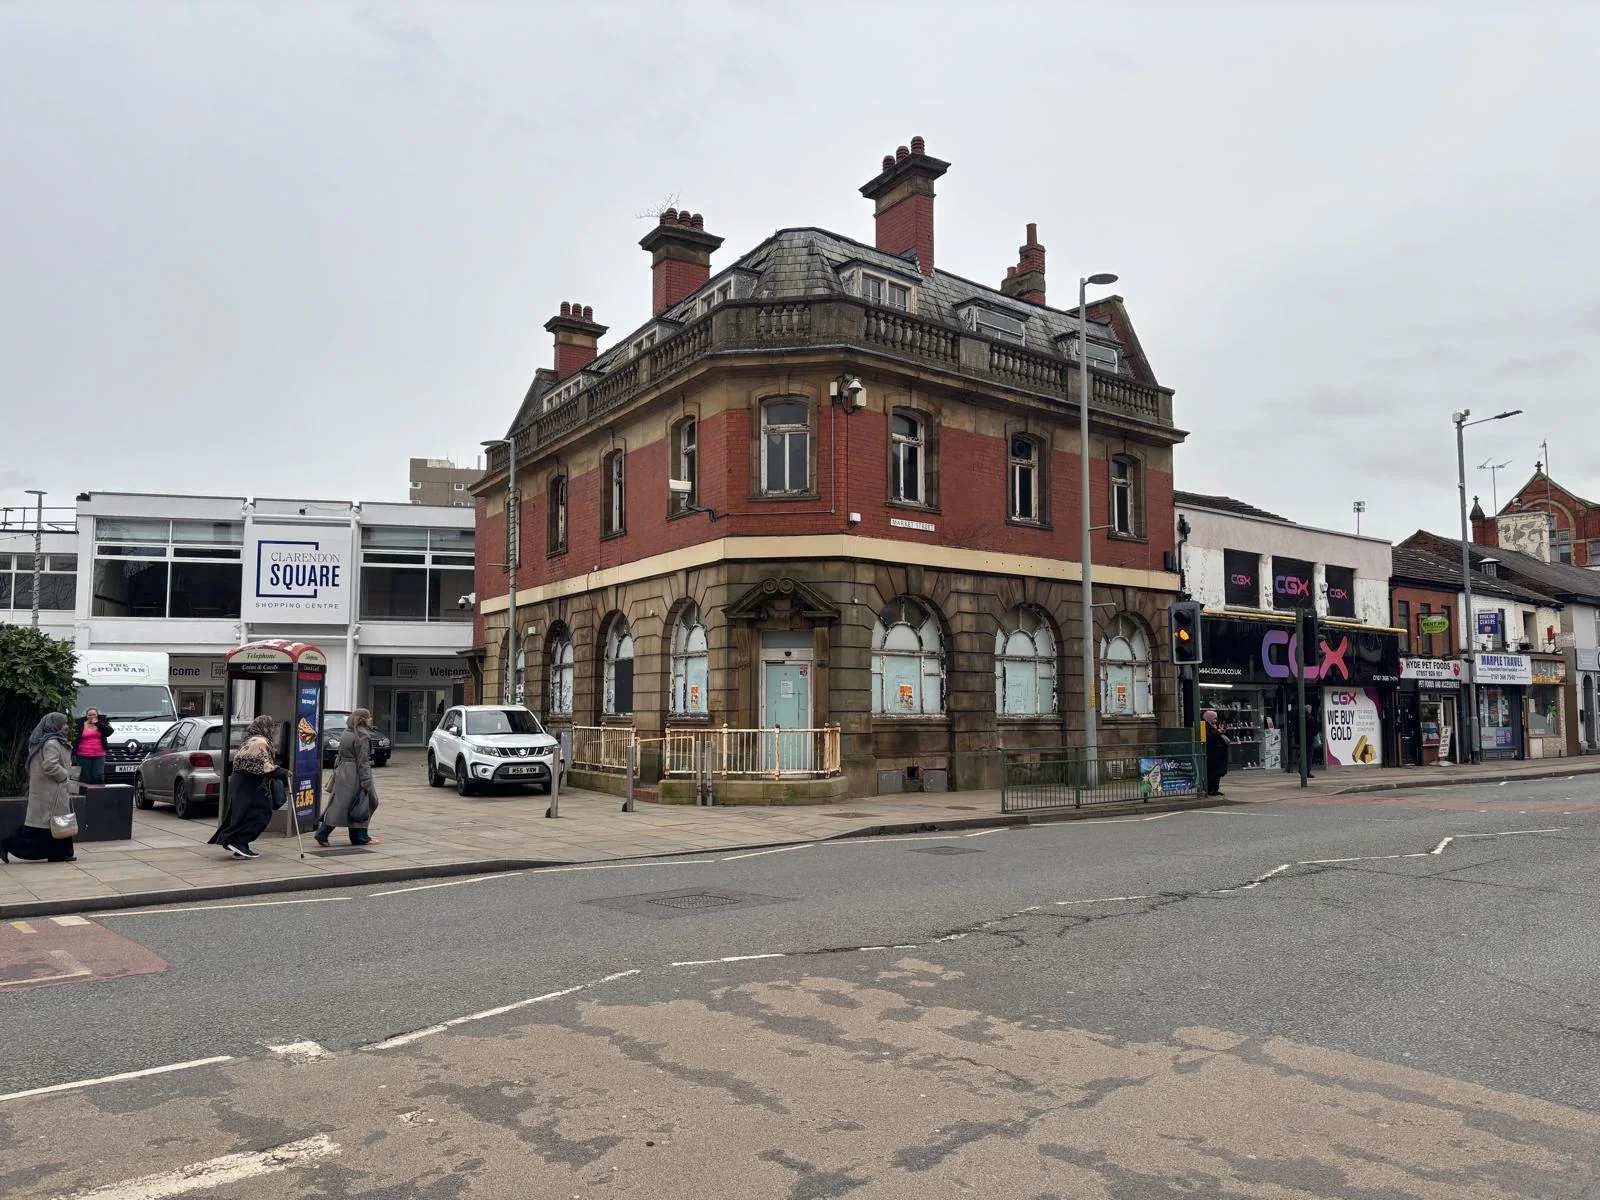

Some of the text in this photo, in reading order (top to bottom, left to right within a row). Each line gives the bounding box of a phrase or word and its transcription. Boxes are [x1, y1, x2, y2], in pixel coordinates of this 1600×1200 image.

[892, 519, 934, 531] MARKET STREET
[271, 552, 340, 563] CLARENDON
[270, 563, 340, 590] SQUARE
[1231, 574, 1252, 587] CGX
[1275, 575, 1309, 597] CGX
[1329, 588, 1348, 600] CGX
[246, 652, 277, 661] Telephone
[1481, 655, 1523, 667] MARPLE TRAVEL
[169, 666, 200, 676] lcome
[1406, 660, 1450, 671] HYDE PET FOODS
[1331, 691, 1357, 705] CGX
[1327, 709, 1340, 726] WE
[1341, 710, 1355, 725] BUY
[1331, 726, 1352, 741] GOLD
